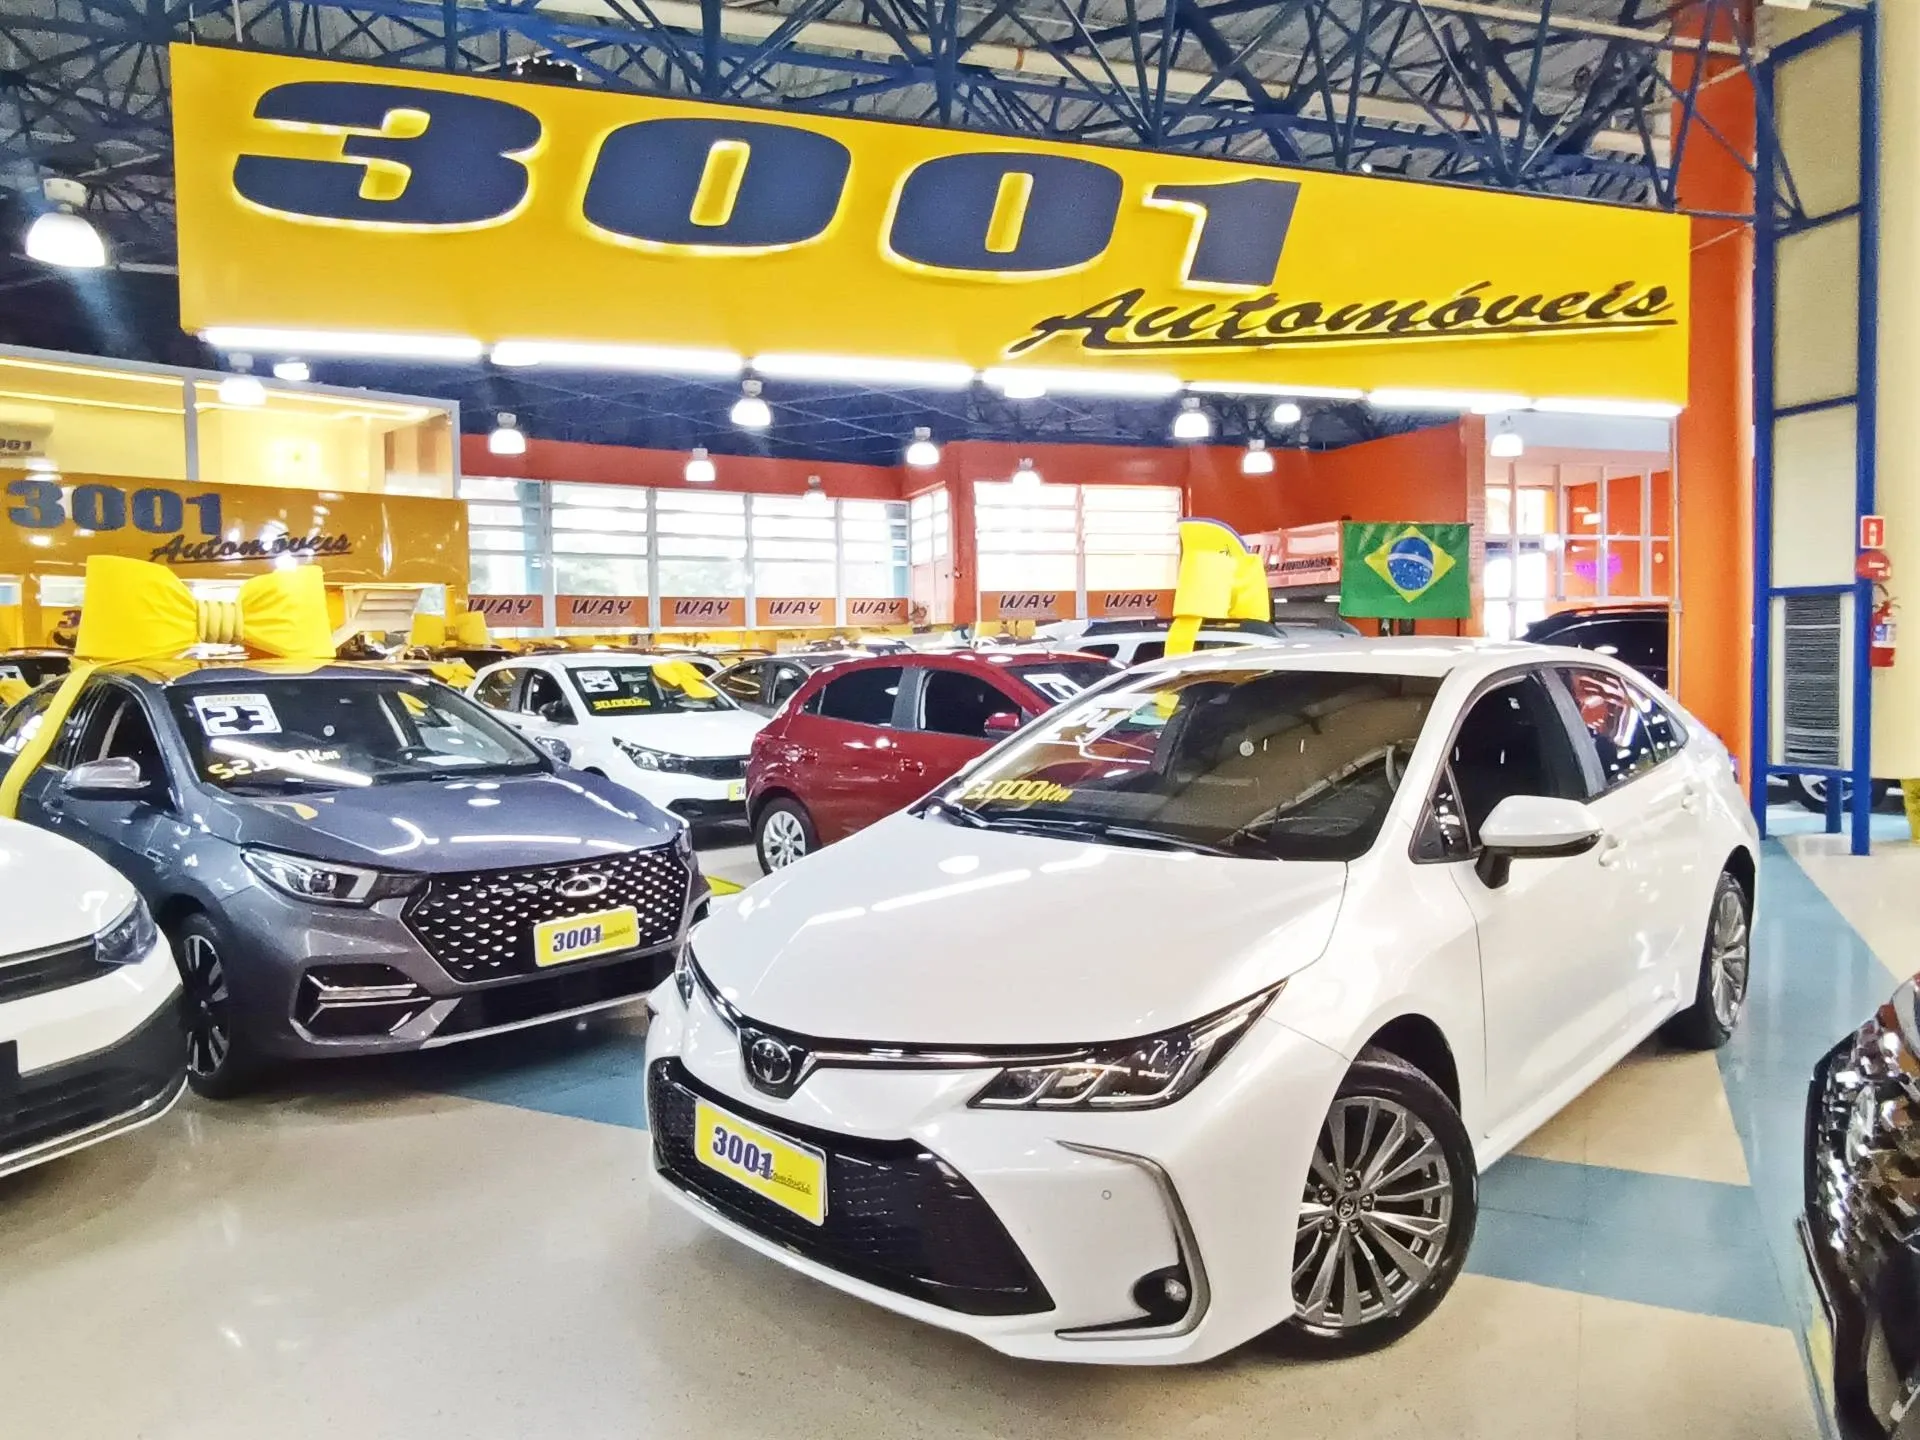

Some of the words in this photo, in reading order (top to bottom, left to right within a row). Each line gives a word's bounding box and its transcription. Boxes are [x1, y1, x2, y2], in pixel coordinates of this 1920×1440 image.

[233, 81, 1301, 289] 3001
[1003, 281, 1677, 352] Automóveis
[7, 480, 223, 535] 3001
[572, 599, 632, 614] WAY
[675, 600, 731, 615] WAY
[769, 600, 821, 615] WAY
[851, 601, 900, 615] WAY
[1000, 594, 1056, 609] WAY
[1104, 593, 1159, 608] WAY
[205, 706, 276, 733] 23
[553, 924, 602, 953] 3001
[712, 1126, 773, 1181] 3001
